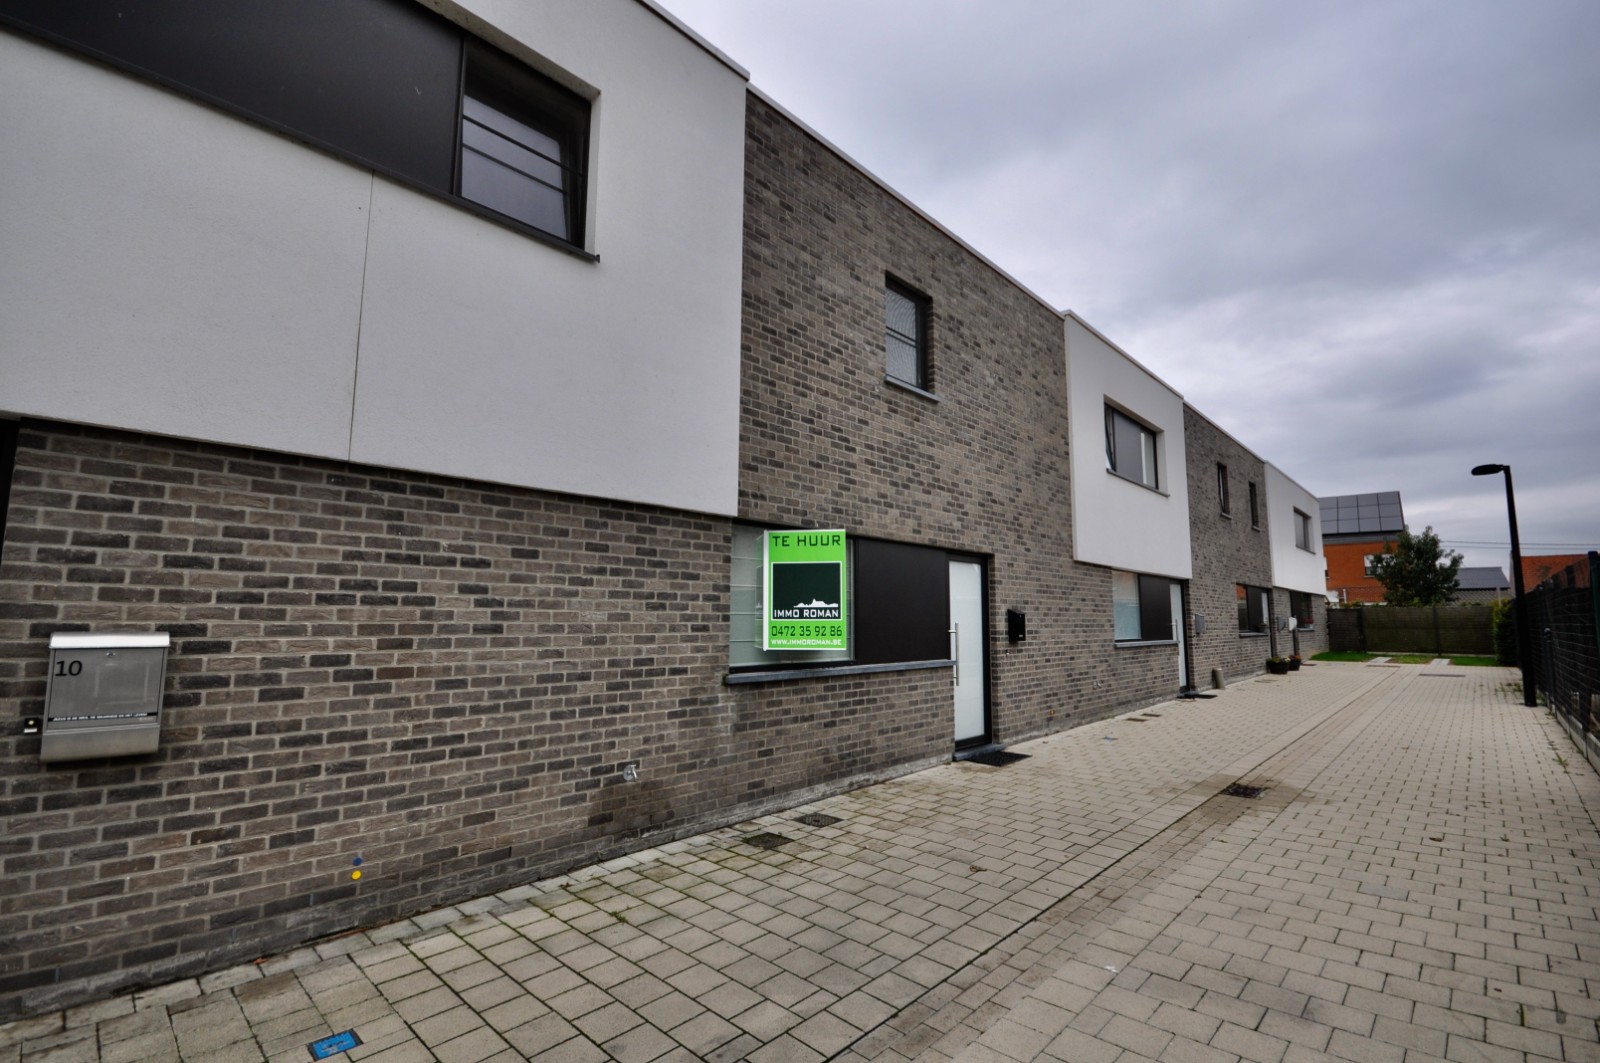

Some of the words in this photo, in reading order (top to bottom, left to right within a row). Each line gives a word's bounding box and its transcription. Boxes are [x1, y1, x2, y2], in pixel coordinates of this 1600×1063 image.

[772, 535, 790, 547] TE
[797, 535, 841, 547] HUUR
[774, 609, 800, 618] IMMO
[803, 609, 839, 618] ROMAN
[771, 625, 796, 637] 0472
[799, 625, 812, 637] 35
[814, 625, 827, 637] 92
[829, 625, 843, 637] 86
[55, 660, 83, 677] 10
